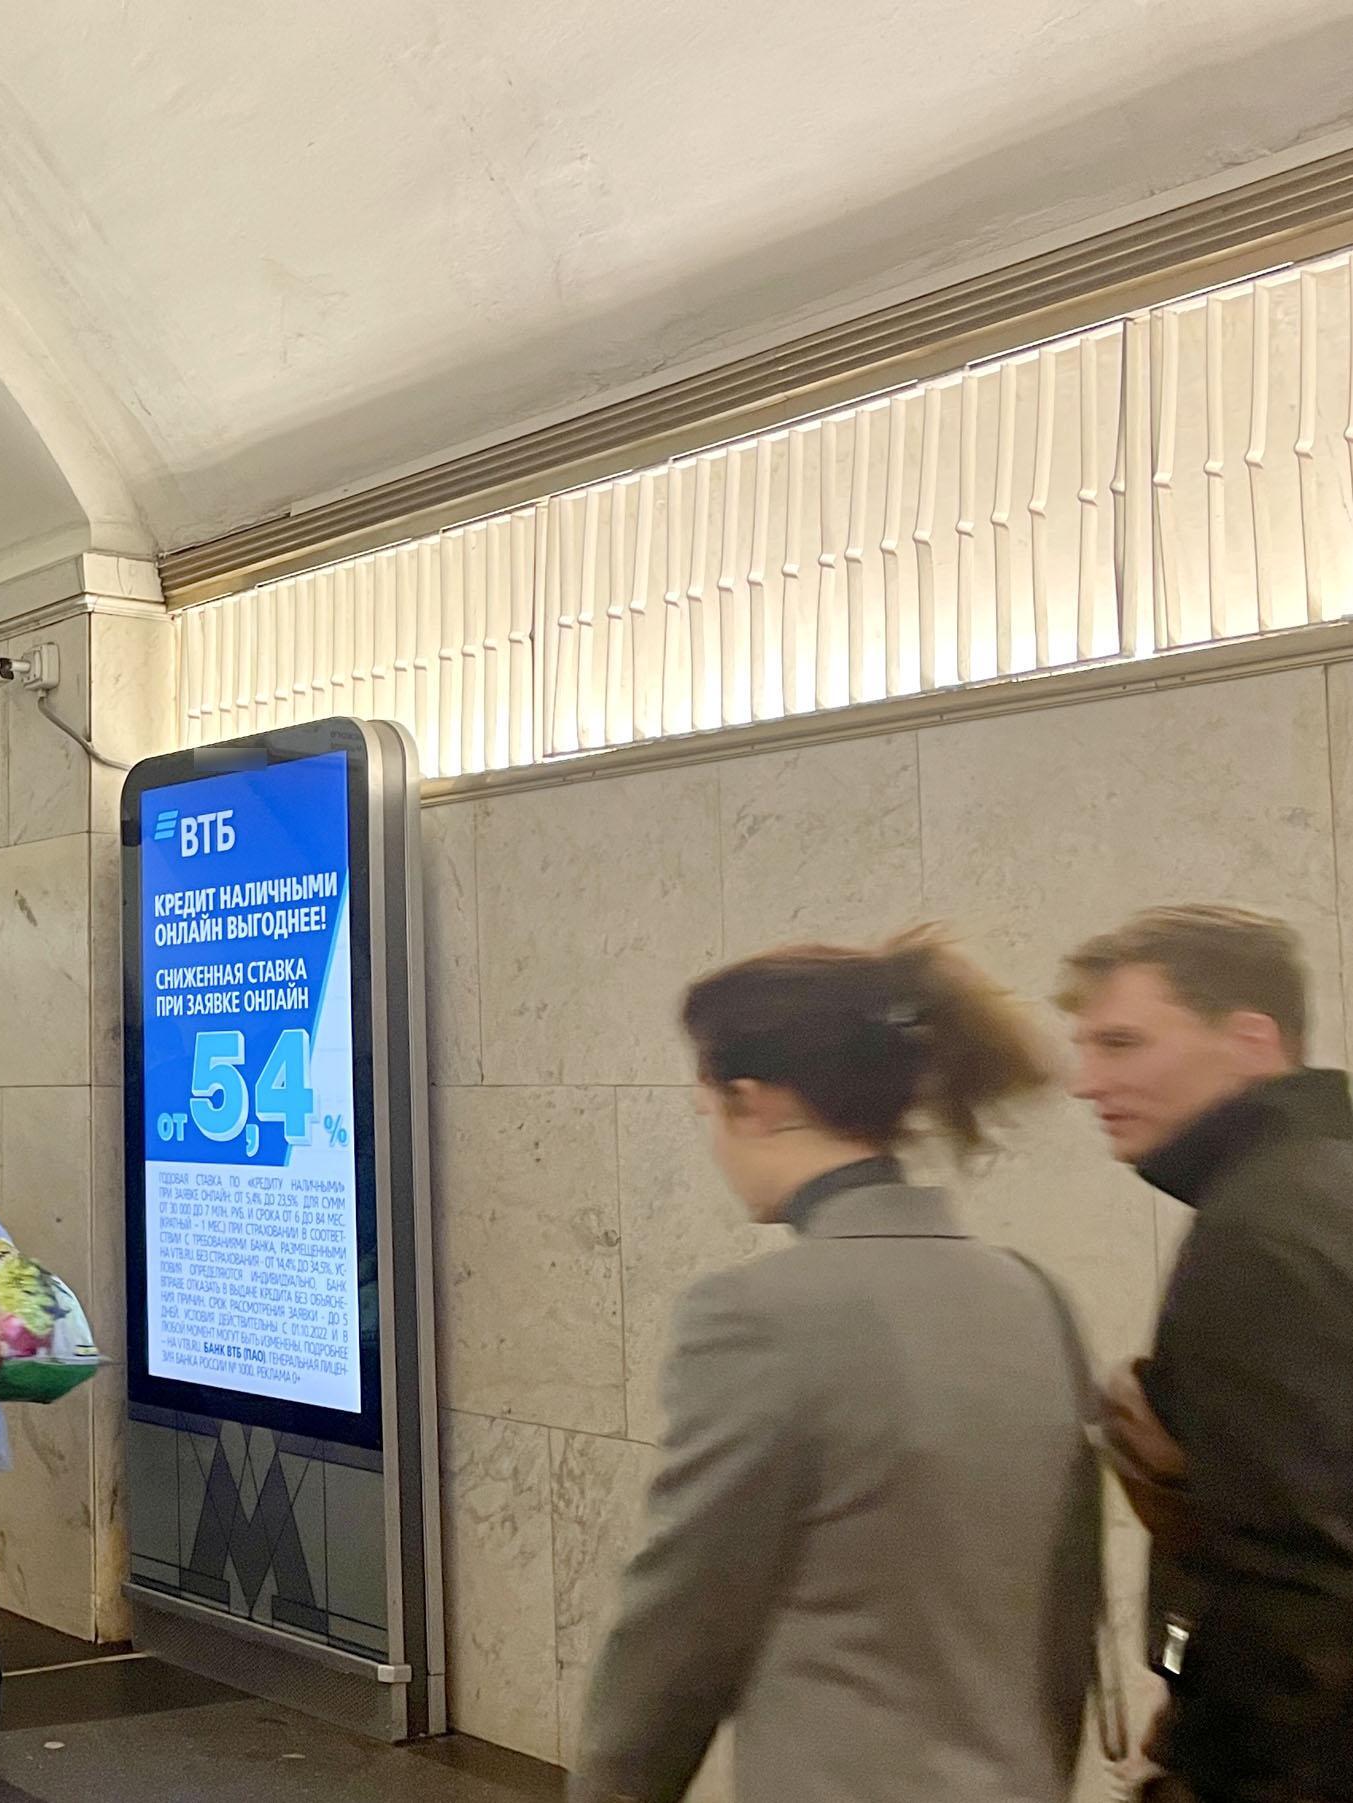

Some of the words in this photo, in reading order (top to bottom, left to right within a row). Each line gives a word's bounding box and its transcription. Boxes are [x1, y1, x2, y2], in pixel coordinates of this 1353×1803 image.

[180, 808, 236, 858] ВТБ
[154, 887, 215, 918] КРЕДИТ
[220, 871, 338, 907] НАЛИЧНЫМИ
[154, 915, 223, 947] ОНЛАЙН
[227, 905, 327, 941] ВЫГОДНЕЕ!
[155, 963, 244, 990] СНИЖЕННАЯ
[247, 957, 308, 984] СТАВКА
[156, 995, 184, 1017] ПРИ
[186, 991, 240, 1014] ЗАЯВКЕ
[244, 982, 309, 1012] ОНЛАЙН
[190, 1028, 316, 1157] 5,4
[229, 1175, 240, 1187] ПО
[233, 1191, 243, 1203] ОТ
[263, 1192, 274, 1204] ДО
[321, 1196, 345, 1209] СУММ
[255, 1207, 280, 1221] СРОКА
[301, 1210, 313, 1223] ДО
[228, 1221, 243, 1234] ПРИ
[309, 1227, 346, 1242] СООТВЕТ-
[264, 1256, 274, 1268] ОТ
[297, 1259, 308, 1272] ДО
[326, 1278, 346, 1292] БАНК
[294, 1291, 308, 1304] БЕЗ
[208, 1296, 226, 1310] СРОК
[327, 1311, 340, 1324] ДО
[203, 1341, 225, 1356] БАНК
[226, 1345, 241, 1358] ВТБ
